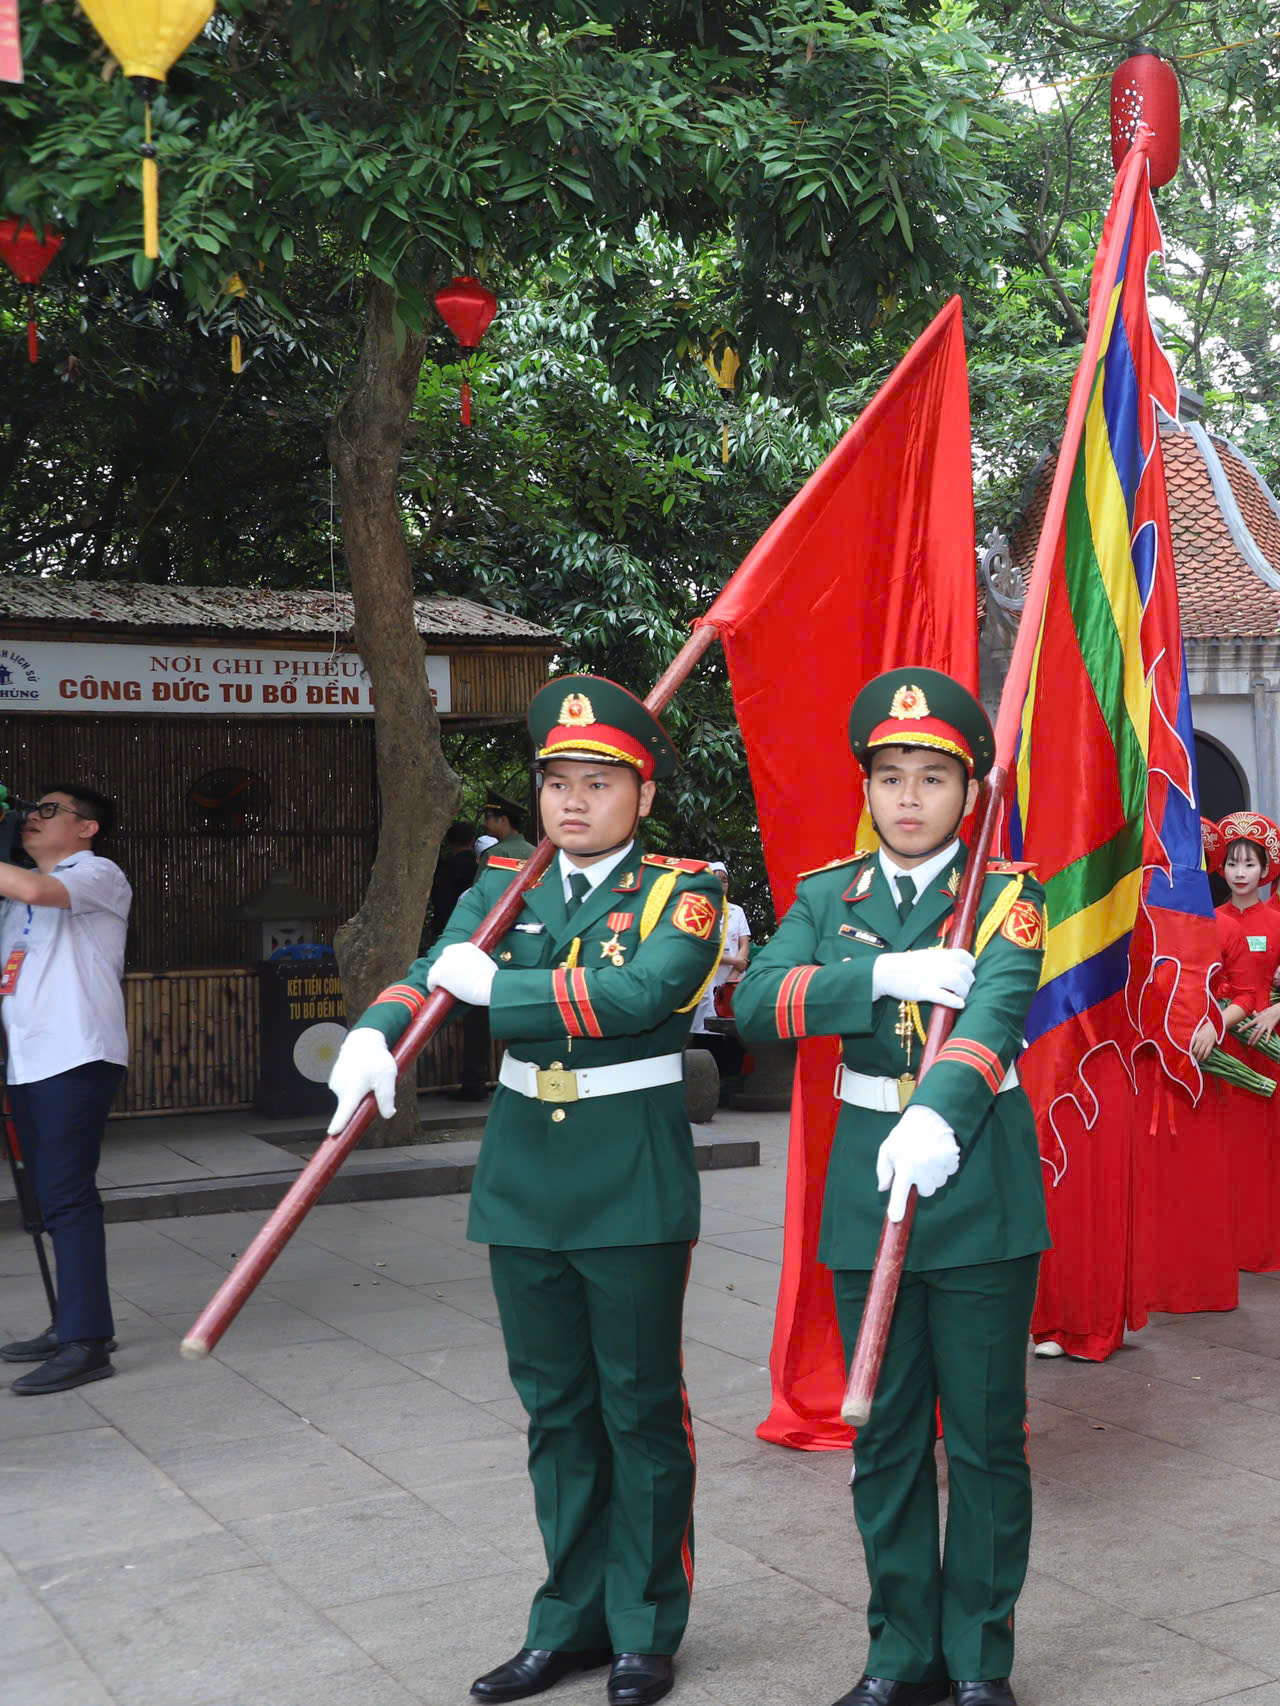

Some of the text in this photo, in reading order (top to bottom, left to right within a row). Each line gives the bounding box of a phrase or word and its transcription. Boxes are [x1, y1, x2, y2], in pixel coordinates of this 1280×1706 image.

[149, 655, 358, 677] NƠI GHI PHIẾU
[59, 675, 142, 701] CÔNG
[152, 677, 210, 702] ĐỨC
[219, 683, 253, 703] TU
[263, 677, 298, 704] BỔ
[306, 679, 360, 705] ĐỀN
